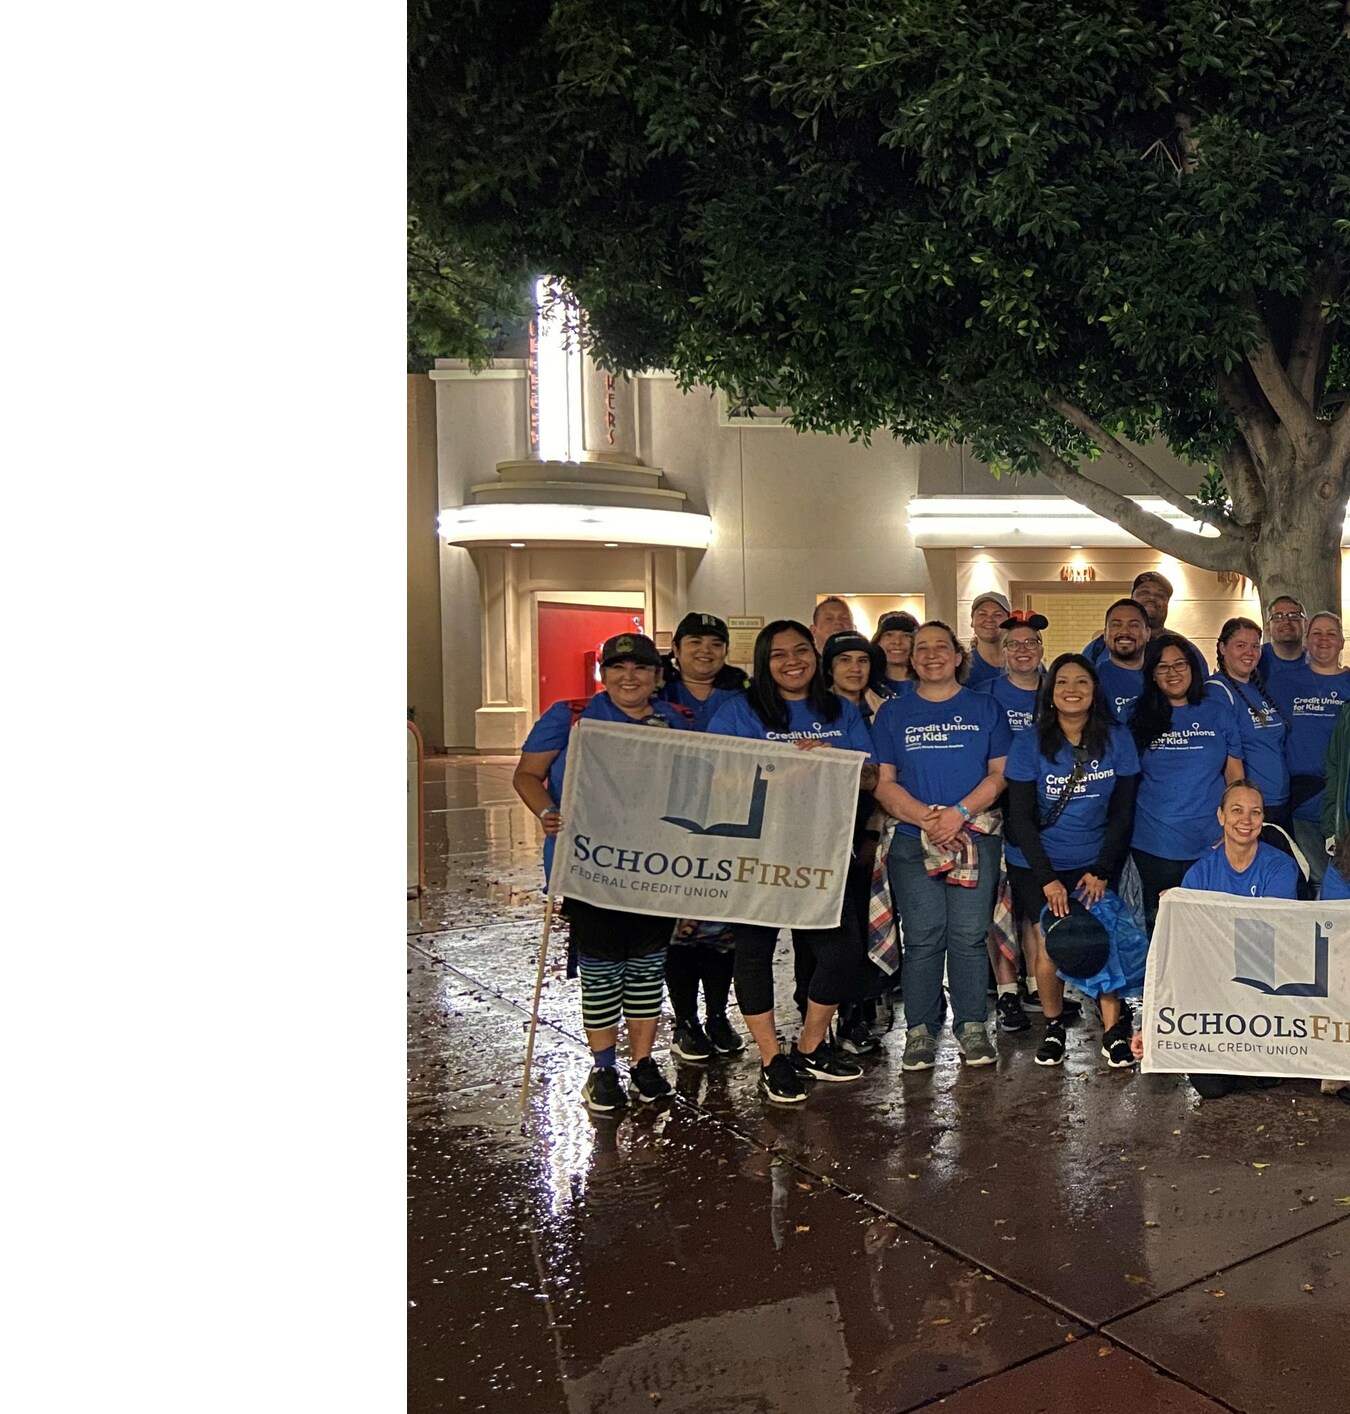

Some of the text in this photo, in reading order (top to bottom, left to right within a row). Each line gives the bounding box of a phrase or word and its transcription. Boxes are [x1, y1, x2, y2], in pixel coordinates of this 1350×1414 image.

[605, 374, 616, 445] KERS
[1321, 697, 1345, 706] Union
[1008, 717, 1023, 725] for
[905, 722, 980, 735] Credit Unions
[1182, 729, 1216, 738] Unions
[766, 729, 842, 740] Credit Unions
[905, 732, 948, 744] for Kids
[1166, 737, 1189, 745] Kids
[1046, 785, 1062, 795] for
[573, 834, 834, 890] SCHOOLSFIRST
[570, 865, 729, 899] FEDERAL CREDIT UNION
[1157, 1040, 1308, 1055] FEDERAL CREDIT UNION
